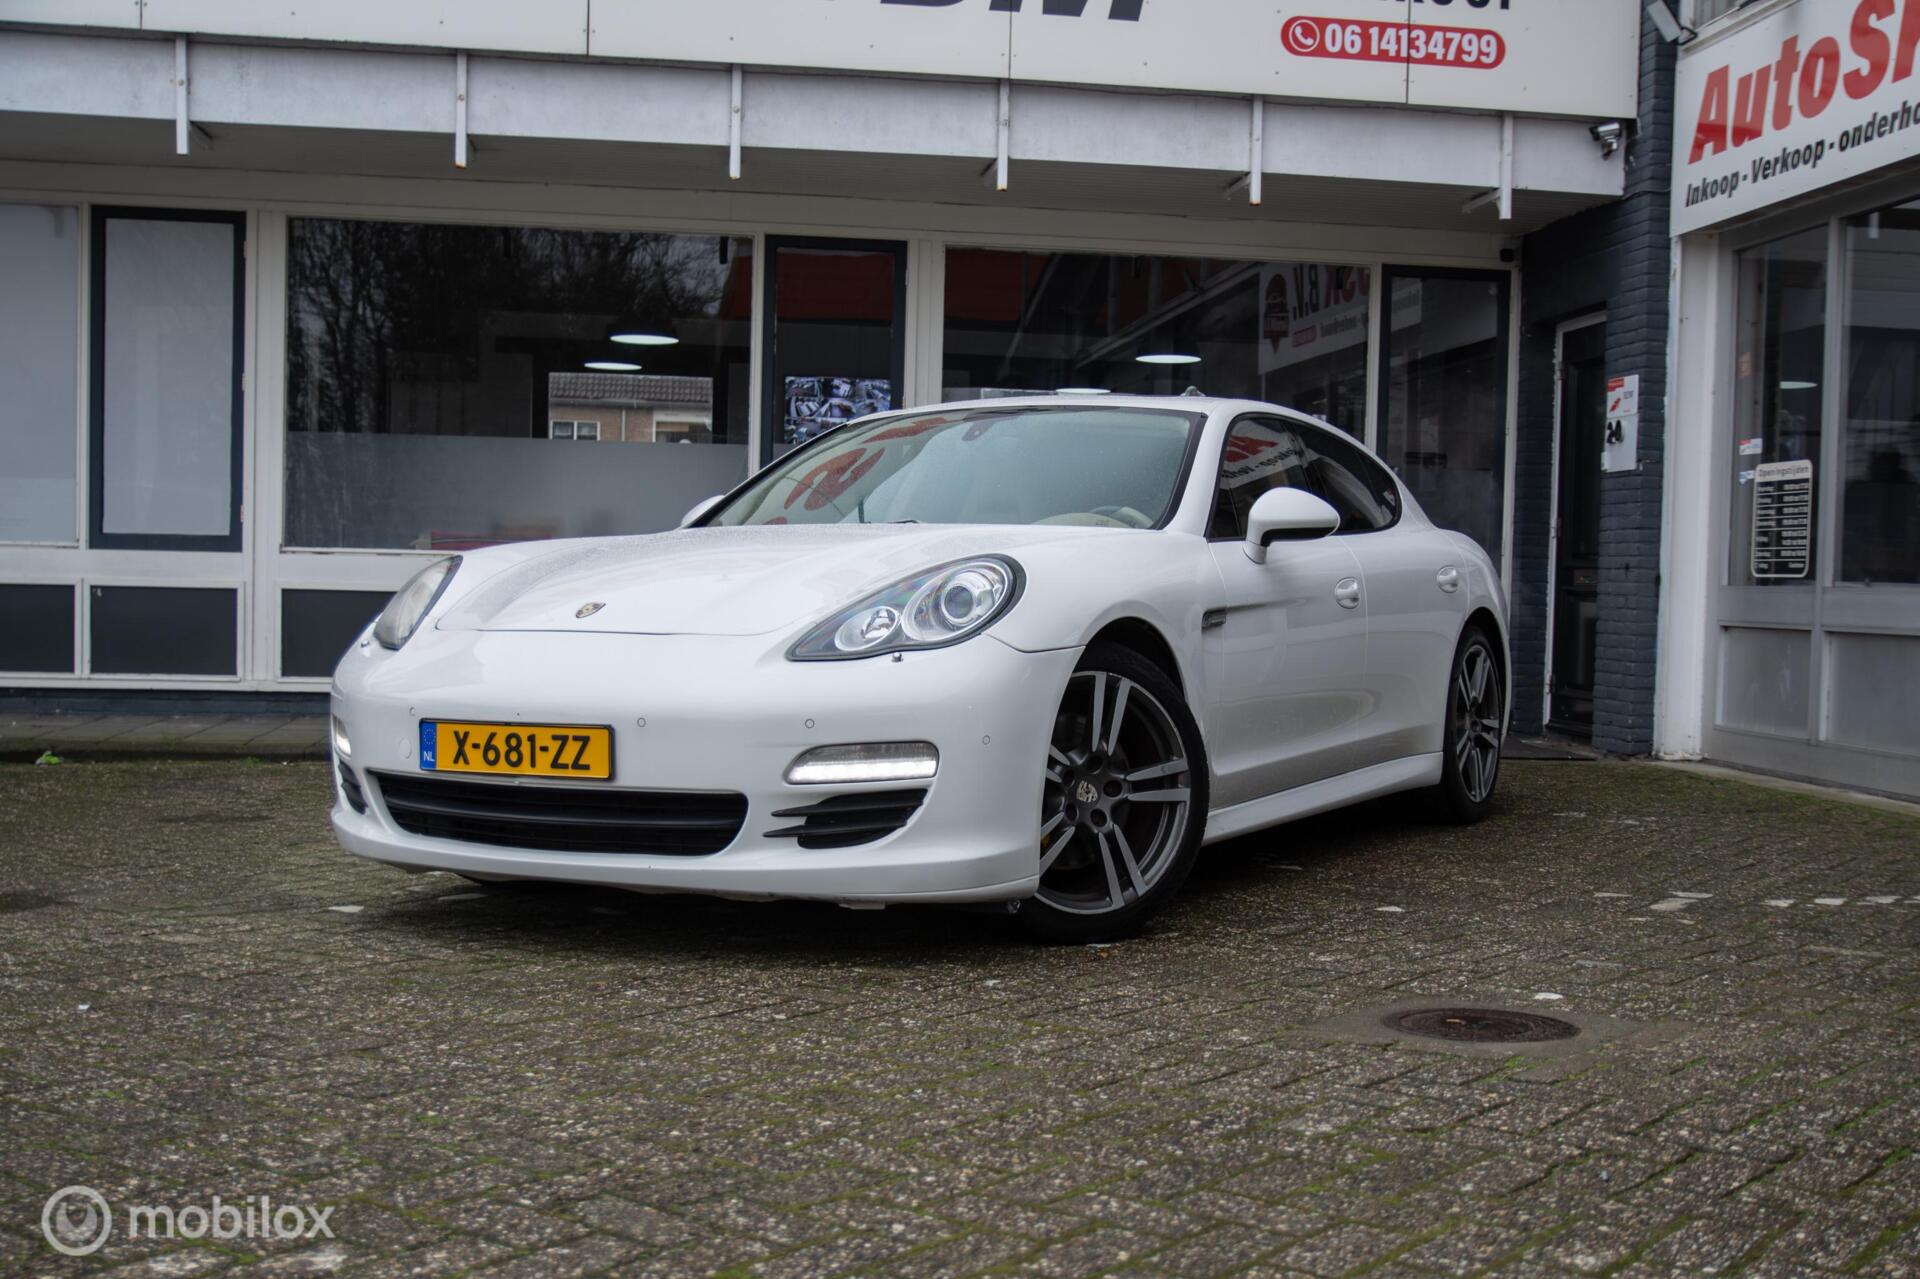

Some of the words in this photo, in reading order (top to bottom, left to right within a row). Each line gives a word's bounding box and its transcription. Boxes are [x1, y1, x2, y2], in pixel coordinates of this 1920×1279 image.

[1324, 23, 1362, 54] 06
[1369, 26, 1498, 64] 14134799
[1685, 171, 1739, 208] Inkoop
[1752, 139, 1825, 184] Verkoop
[423, 751, 435, 762] NL
[453, 730, 591, 770] X-681-ZZ
